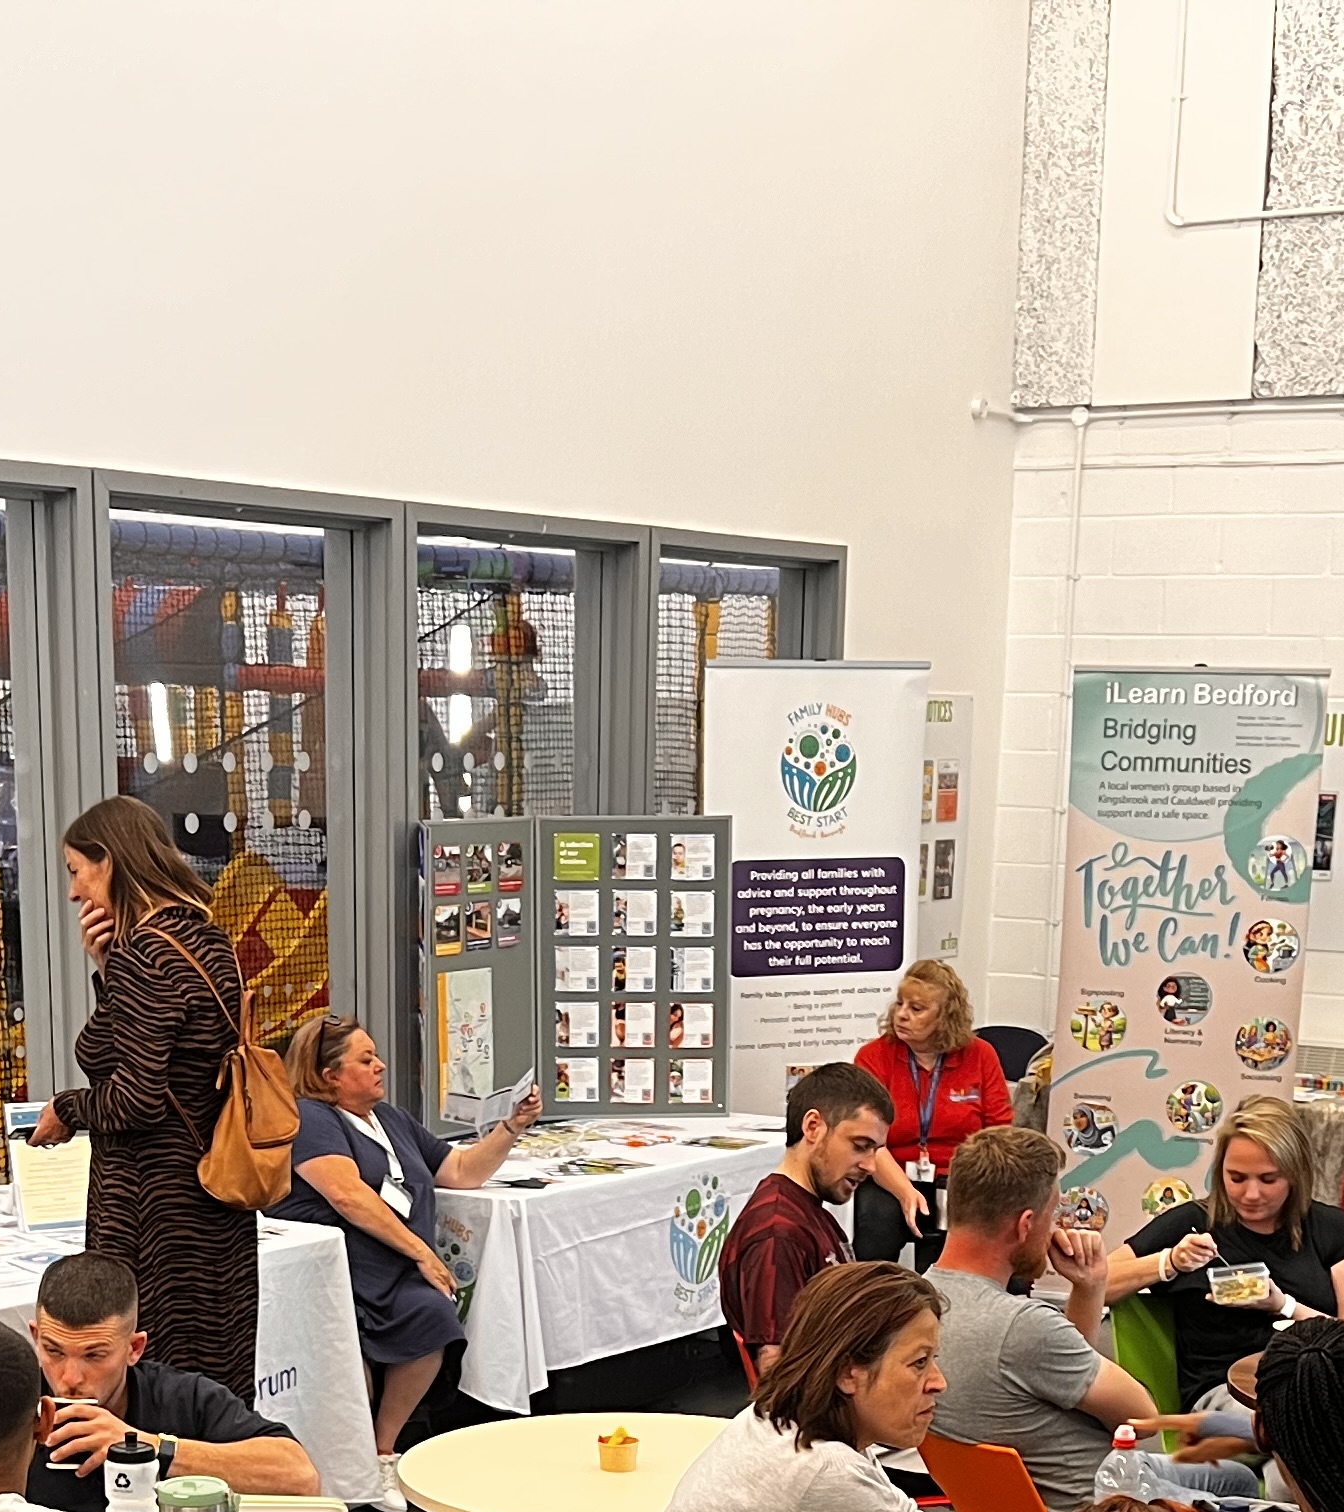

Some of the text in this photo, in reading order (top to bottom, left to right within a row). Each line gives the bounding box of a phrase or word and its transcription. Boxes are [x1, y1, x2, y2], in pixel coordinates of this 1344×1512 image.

[1105, 681, 1298, 707] iLearn Bedford
[787, 702, 852, 727] FAMILY HUBS
[1103, 718, 1196, 745] Bridging
[1100, 750, 1252, 774] Communities
[1099, 781, 1242, 794] A local women's group based in
[1152, 796, 1169, 805] and
[1217, 799, 1263, 810] providing
[787, 806, 848, 828] BEST START
[1097, 809, 1132, 820] support
[1134, 810, 1152, 819] and
[1161, 810, 1180, 819] safe
[750, 867, 886, 882] Providing all families with
[737, 884, 897, 900] advice and support throughout
[1075, 842, 1237, 931] Together
[749, 902, 886, 918] pregnancy, the early years
[735, 919, 898, 935] and beyond, to ensure everyone
[743, 936, 891, 951] has the opportunity to reach
[1099, 911, 1241, 967] We Can!
[768, 953, 864, 967] their full potential.
[258, 1366, 297, 1400] rum
